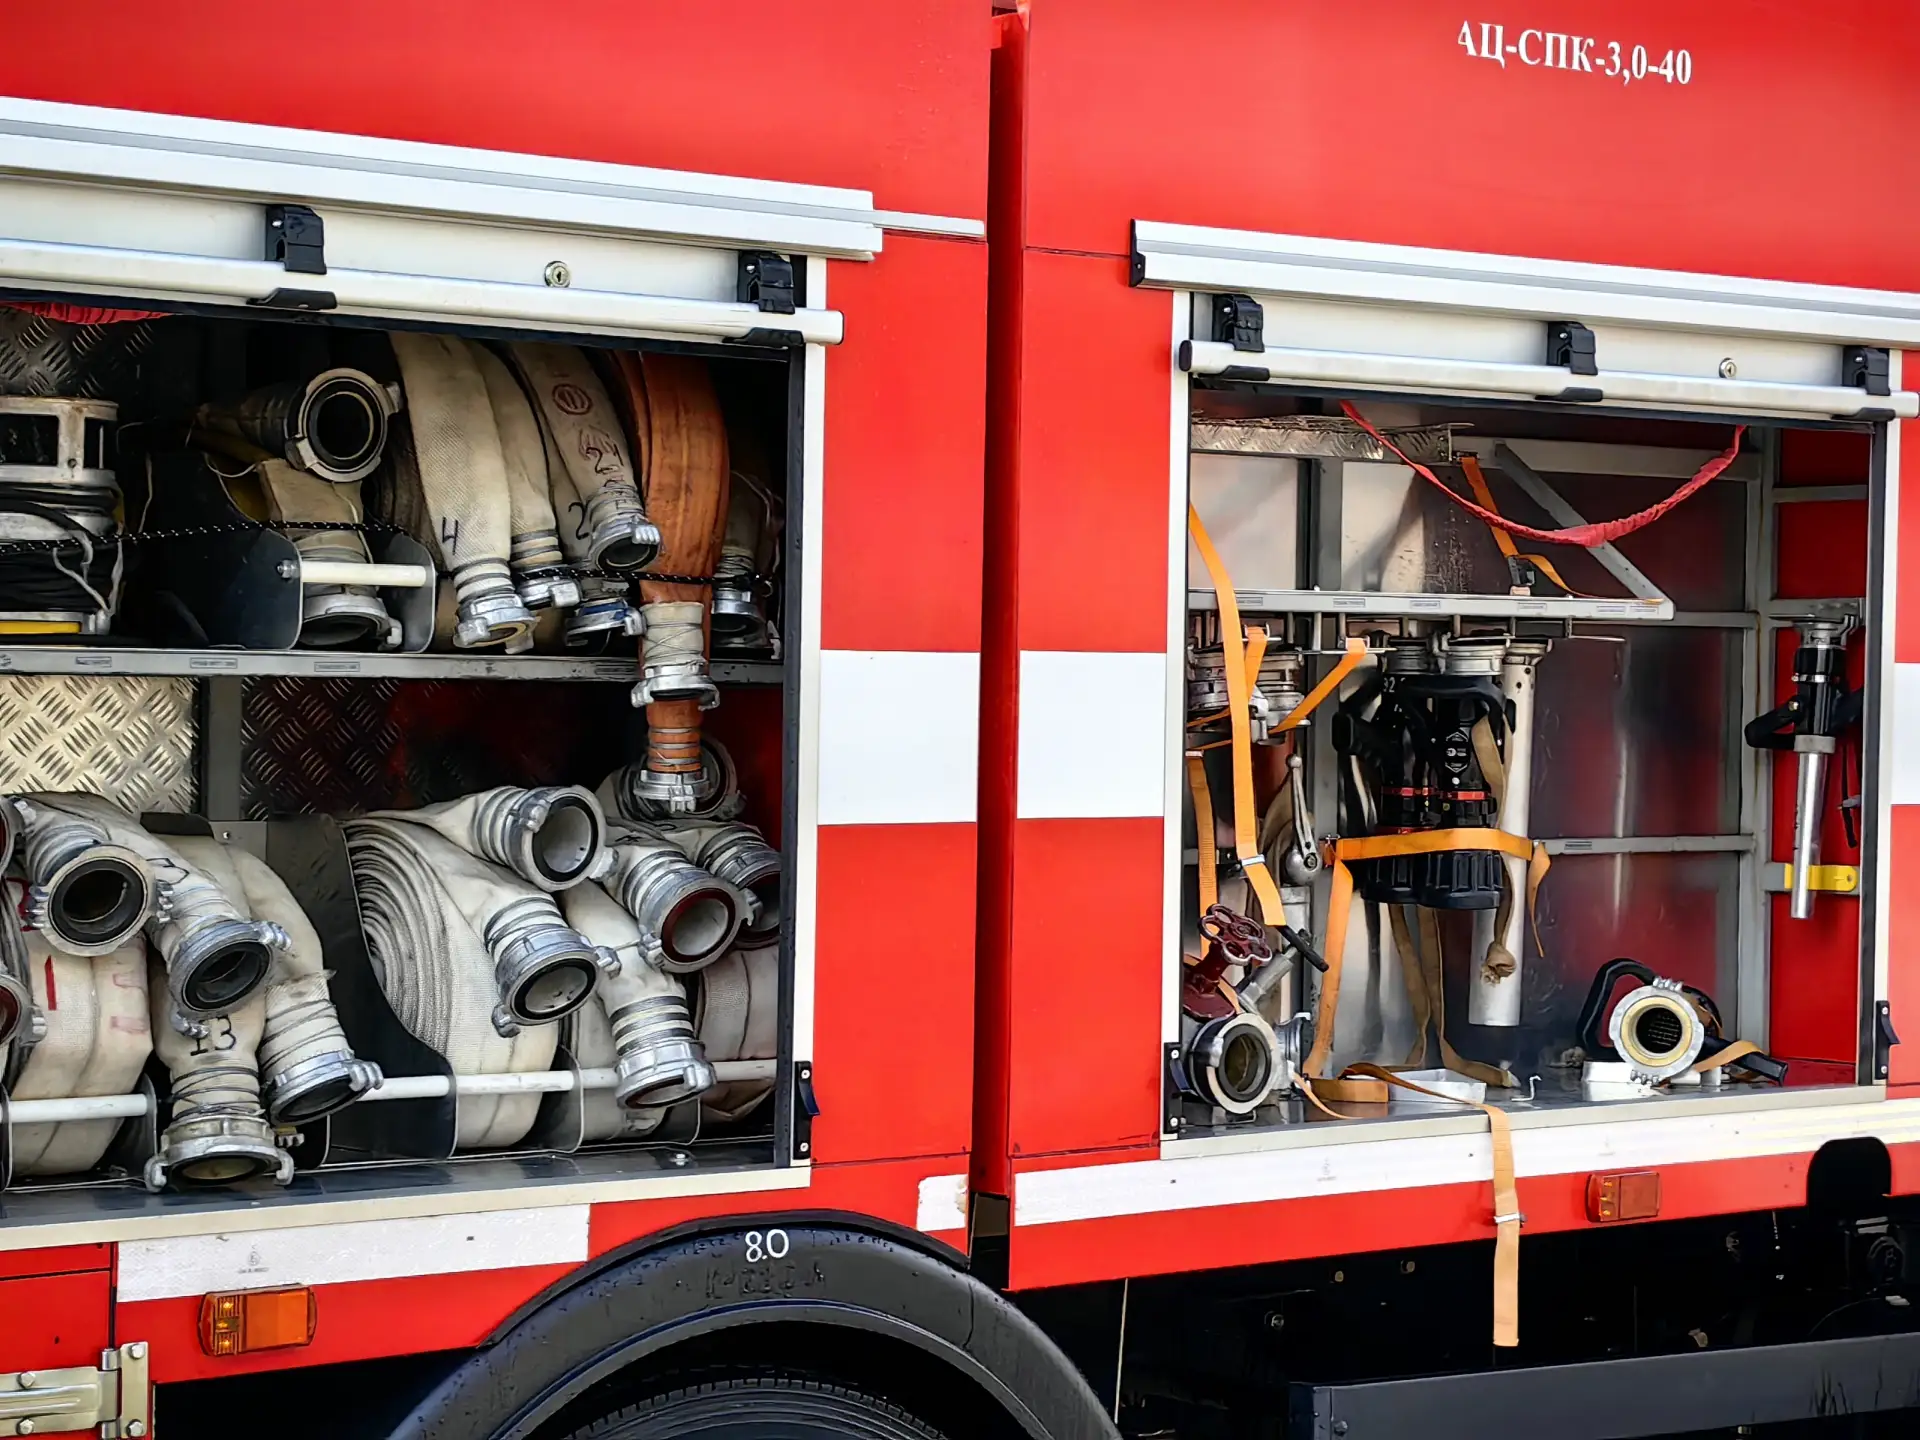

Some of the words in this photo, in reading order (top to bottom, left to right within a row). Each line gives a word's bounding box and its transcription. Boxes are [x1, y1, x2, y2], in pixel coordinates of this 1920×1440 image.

[1457, 20, 1692, 85] АЦ-СПК-3,0-40
[442, 516, 458, 556] 4
[745, 1229, 789, 1262] 8.0
